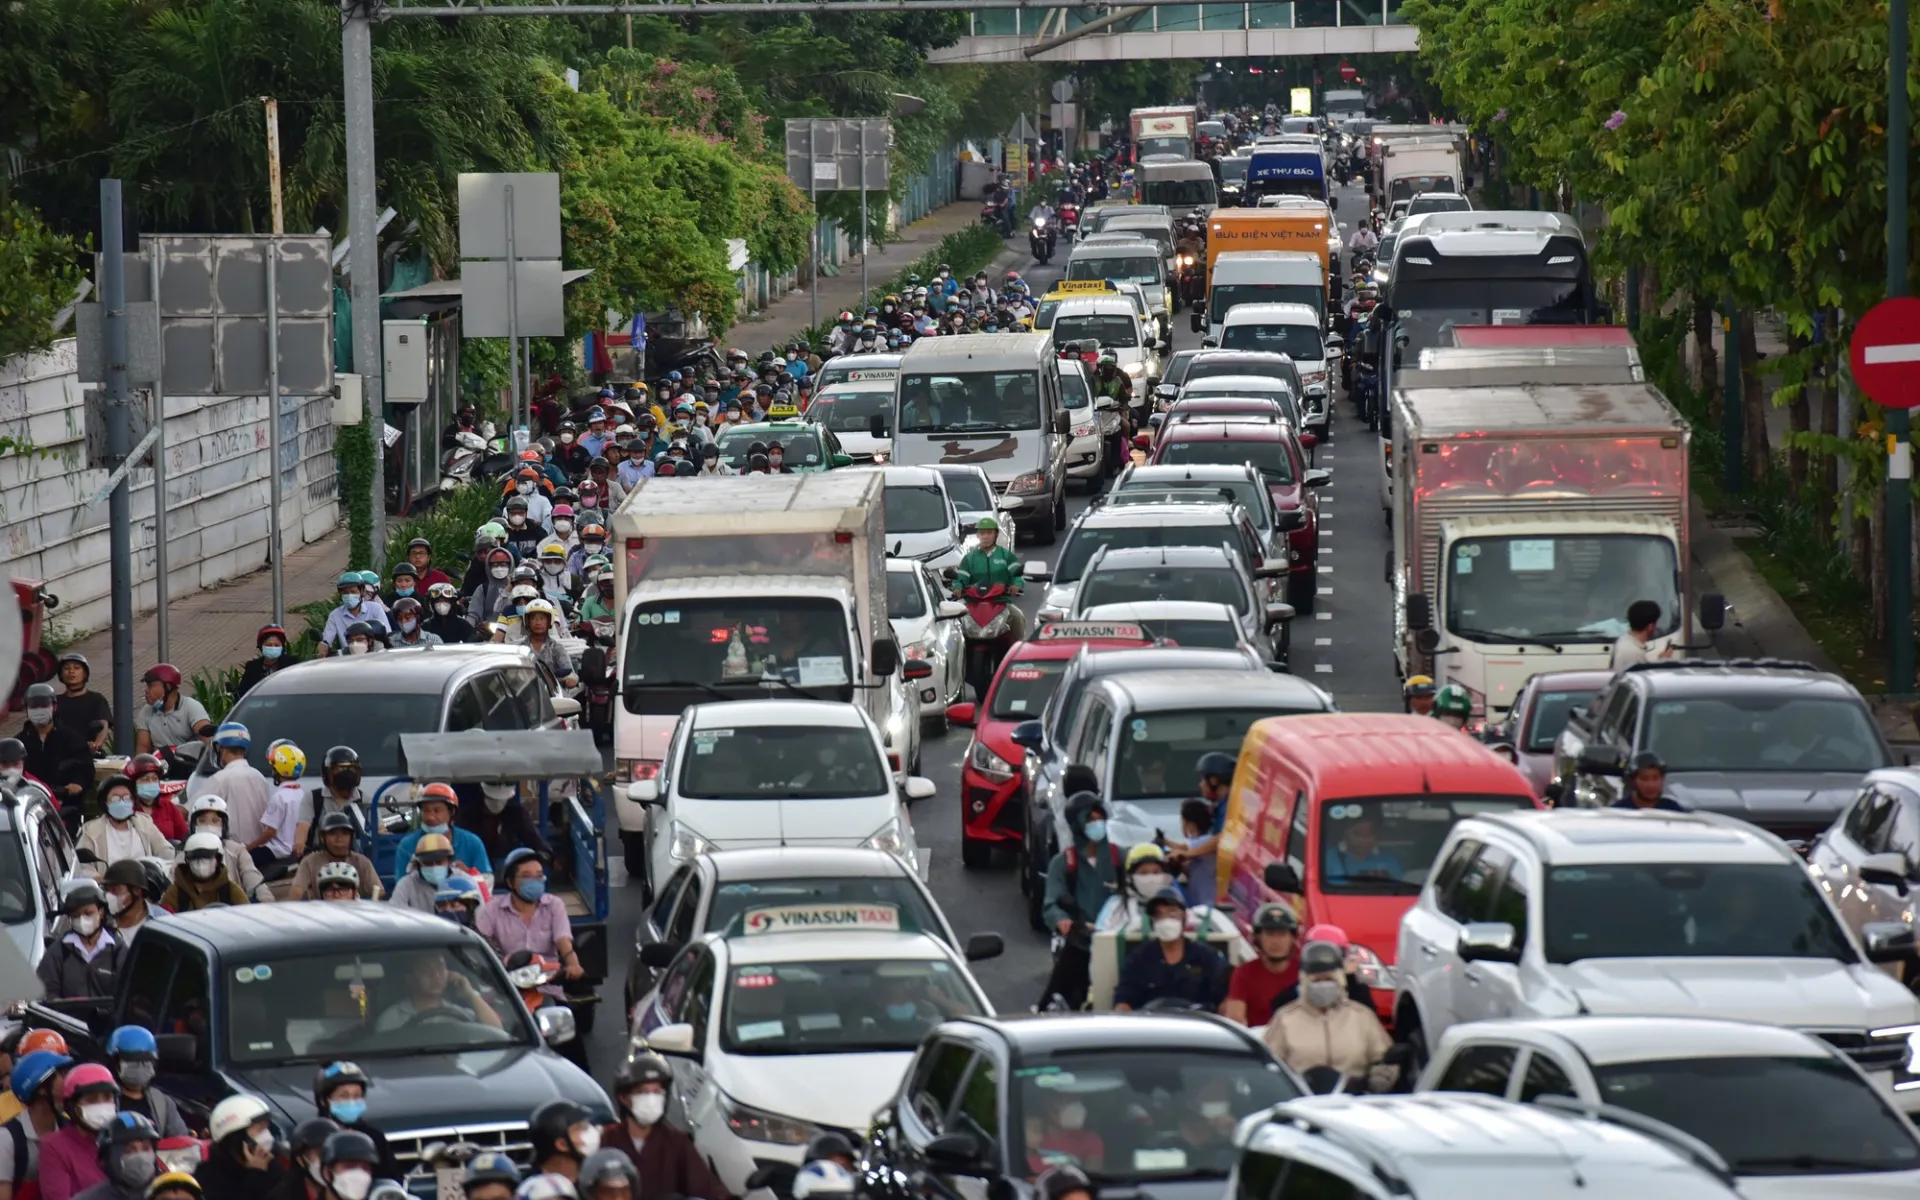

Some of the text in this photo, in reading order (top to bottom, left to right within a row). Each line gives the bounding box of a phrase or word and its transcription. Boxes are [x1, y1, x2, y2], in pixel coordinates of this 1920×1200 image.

[1061, 280, 1102, 289] Vinataxi
[863, 371, 895, 379] VINASUN
[1062, 626, 1138, 637] VINASUN TAXI
[780, 908, 893, 925] VINASUN TAXI
